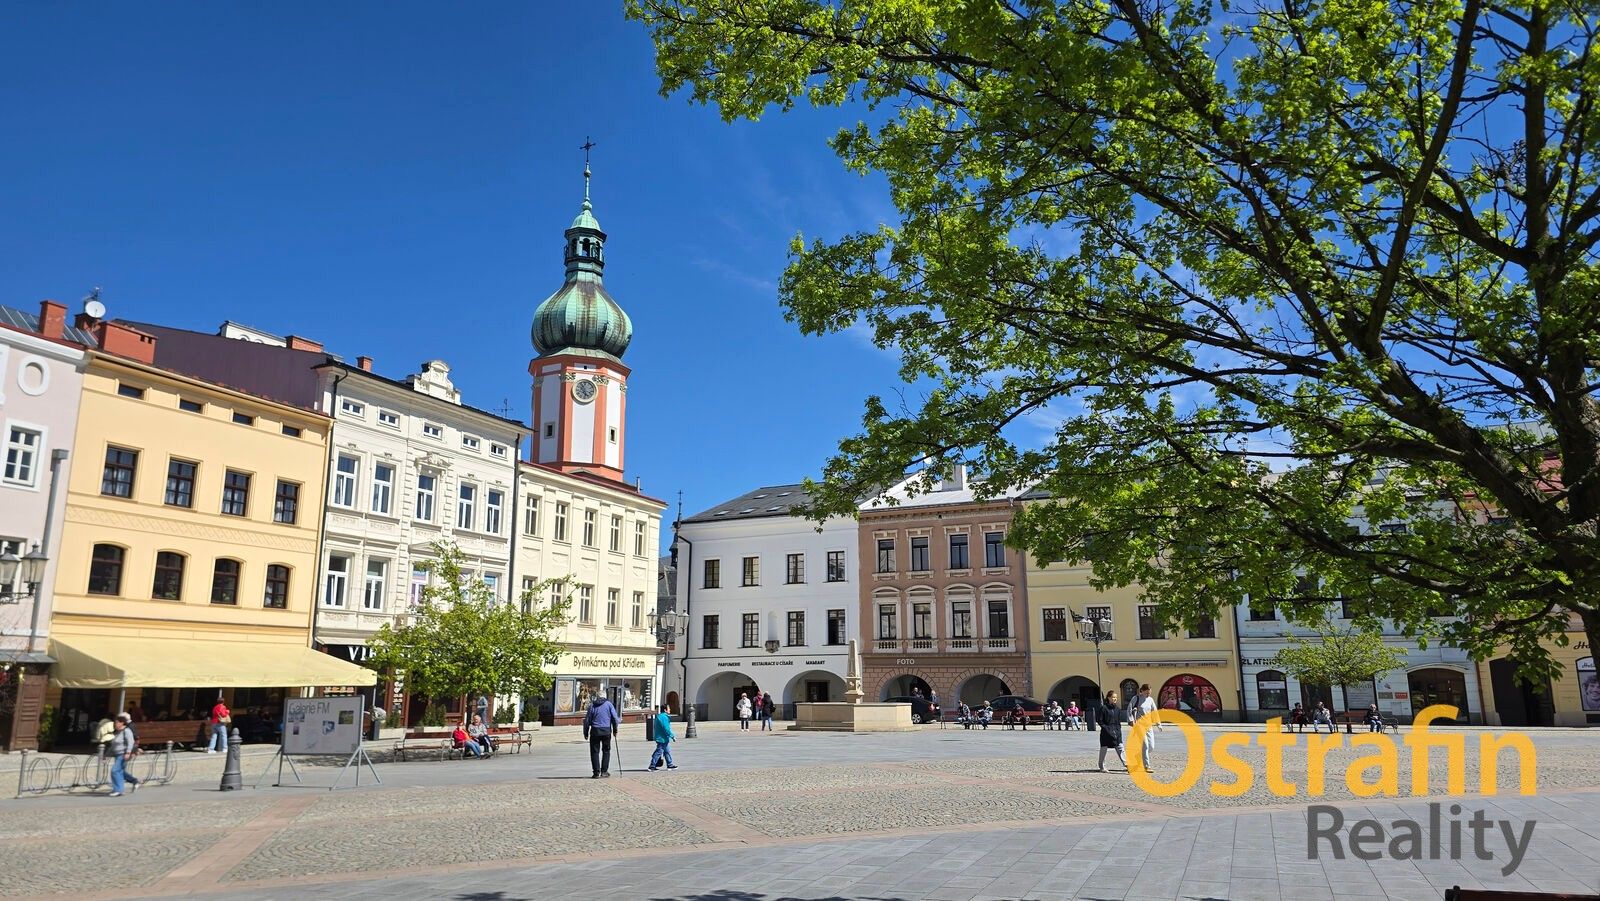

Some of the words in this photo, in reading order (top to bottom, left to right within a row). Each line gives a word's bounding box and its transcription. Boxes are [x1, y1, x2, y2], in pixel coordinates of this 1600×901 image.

[573, 656, 608, 670] Bylinkárna
[609, 660, 621, 670] pod
[622, 657, 646, 669] Křídlem
[289, 701, 316, 715] Galerie
[317, 701, 330, 715] FM
